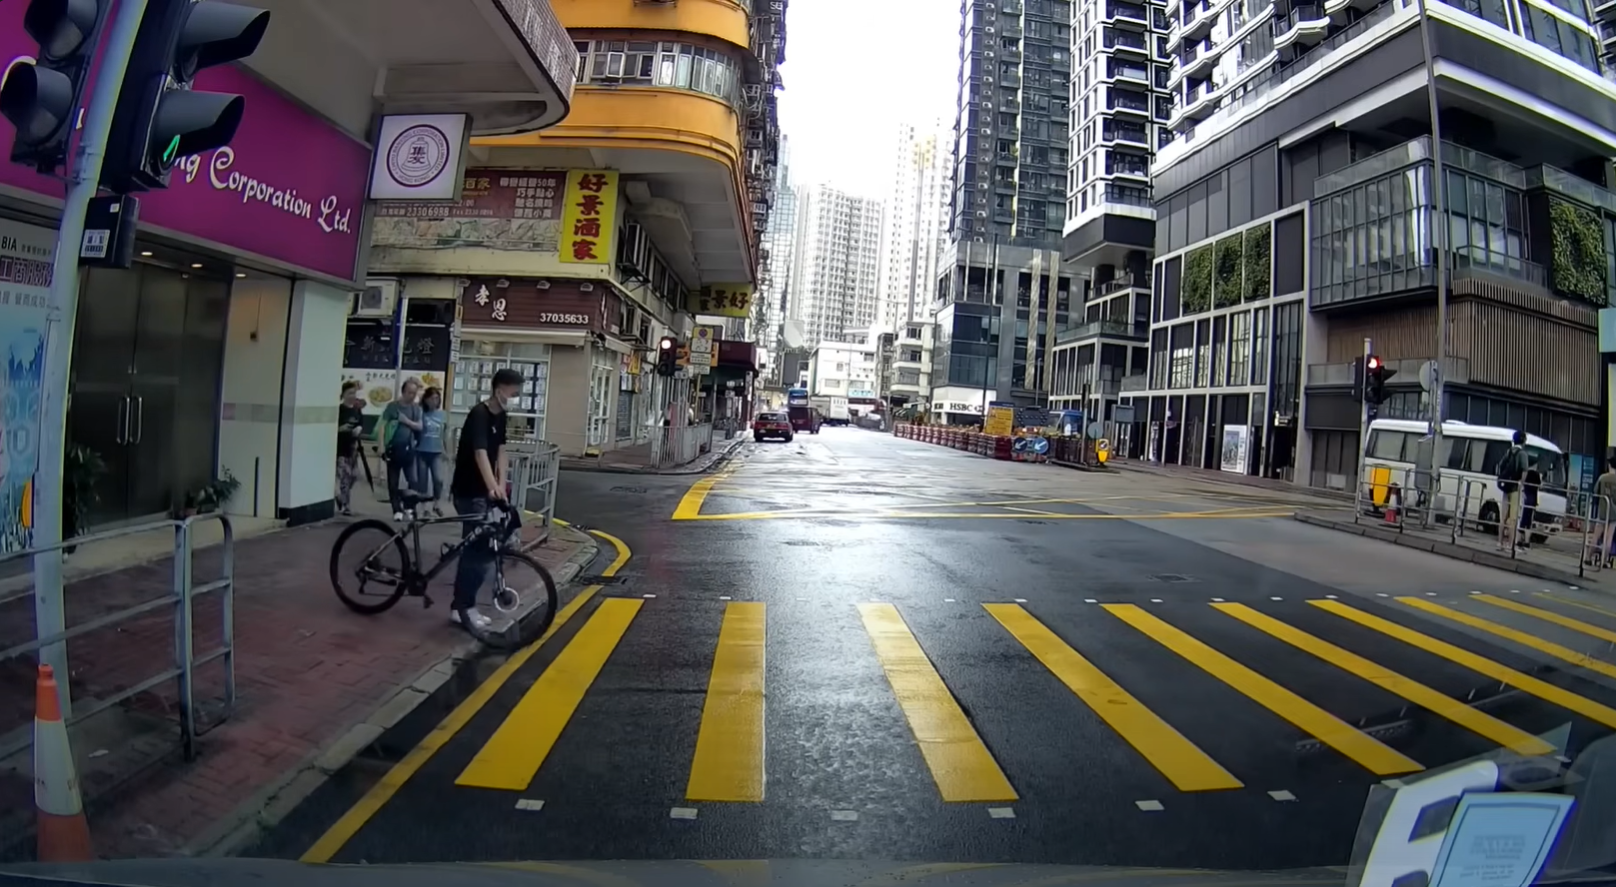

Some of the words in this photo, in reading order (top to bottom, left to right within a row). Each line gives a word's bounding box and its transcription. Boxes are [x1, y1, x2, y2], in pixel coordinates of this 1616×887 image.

[210, 146, 312, 219] Corporation
[317, 195, 351, 233] Ltd.
[572, 173, 609, 261] 好景酒家
[539, 313, 589, 325] 37035633
[950, 402, 973, 412] HSBC
